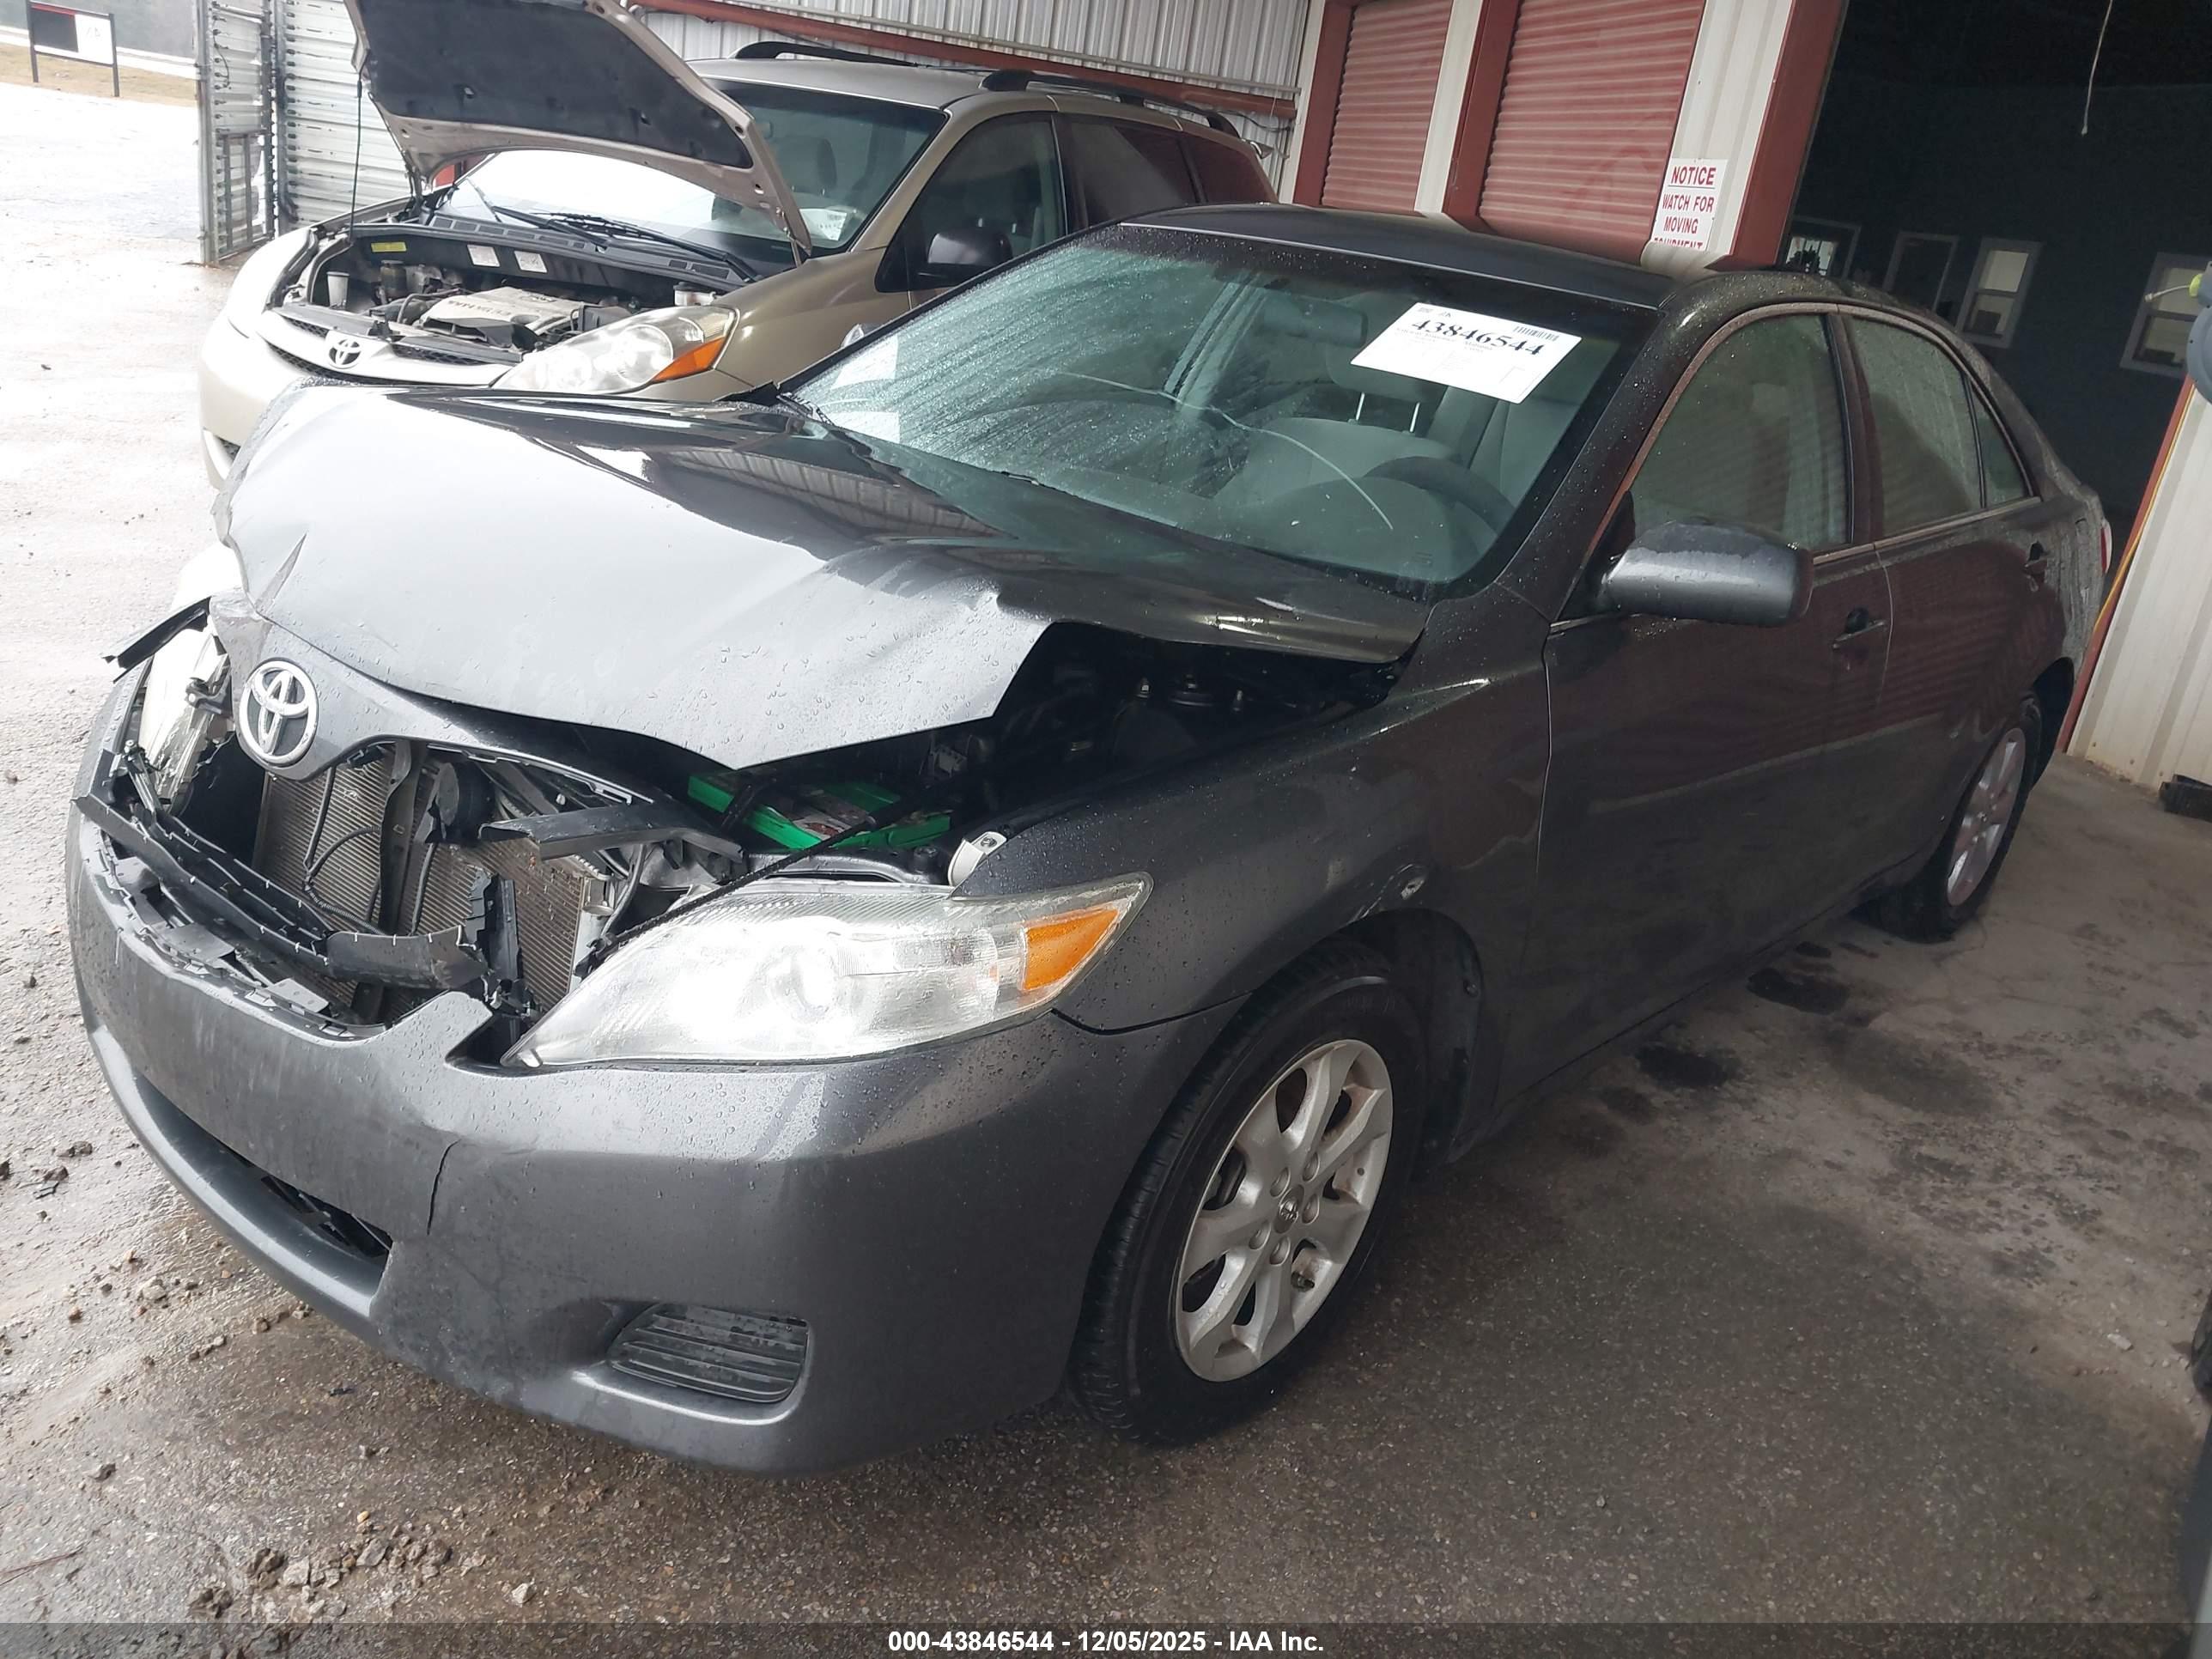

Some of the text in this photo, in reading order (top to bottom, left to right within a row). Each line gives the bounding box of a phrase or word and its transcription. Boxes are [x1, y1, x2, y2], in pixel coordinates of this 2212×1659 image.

[1671, 166, 1717, 185] NOTICE
[1662, 194, 1715, 212] WATCH FOR
[1663, 216, 1698, 234] MOVING
[1412, 319, 1545, 356] 43846544
